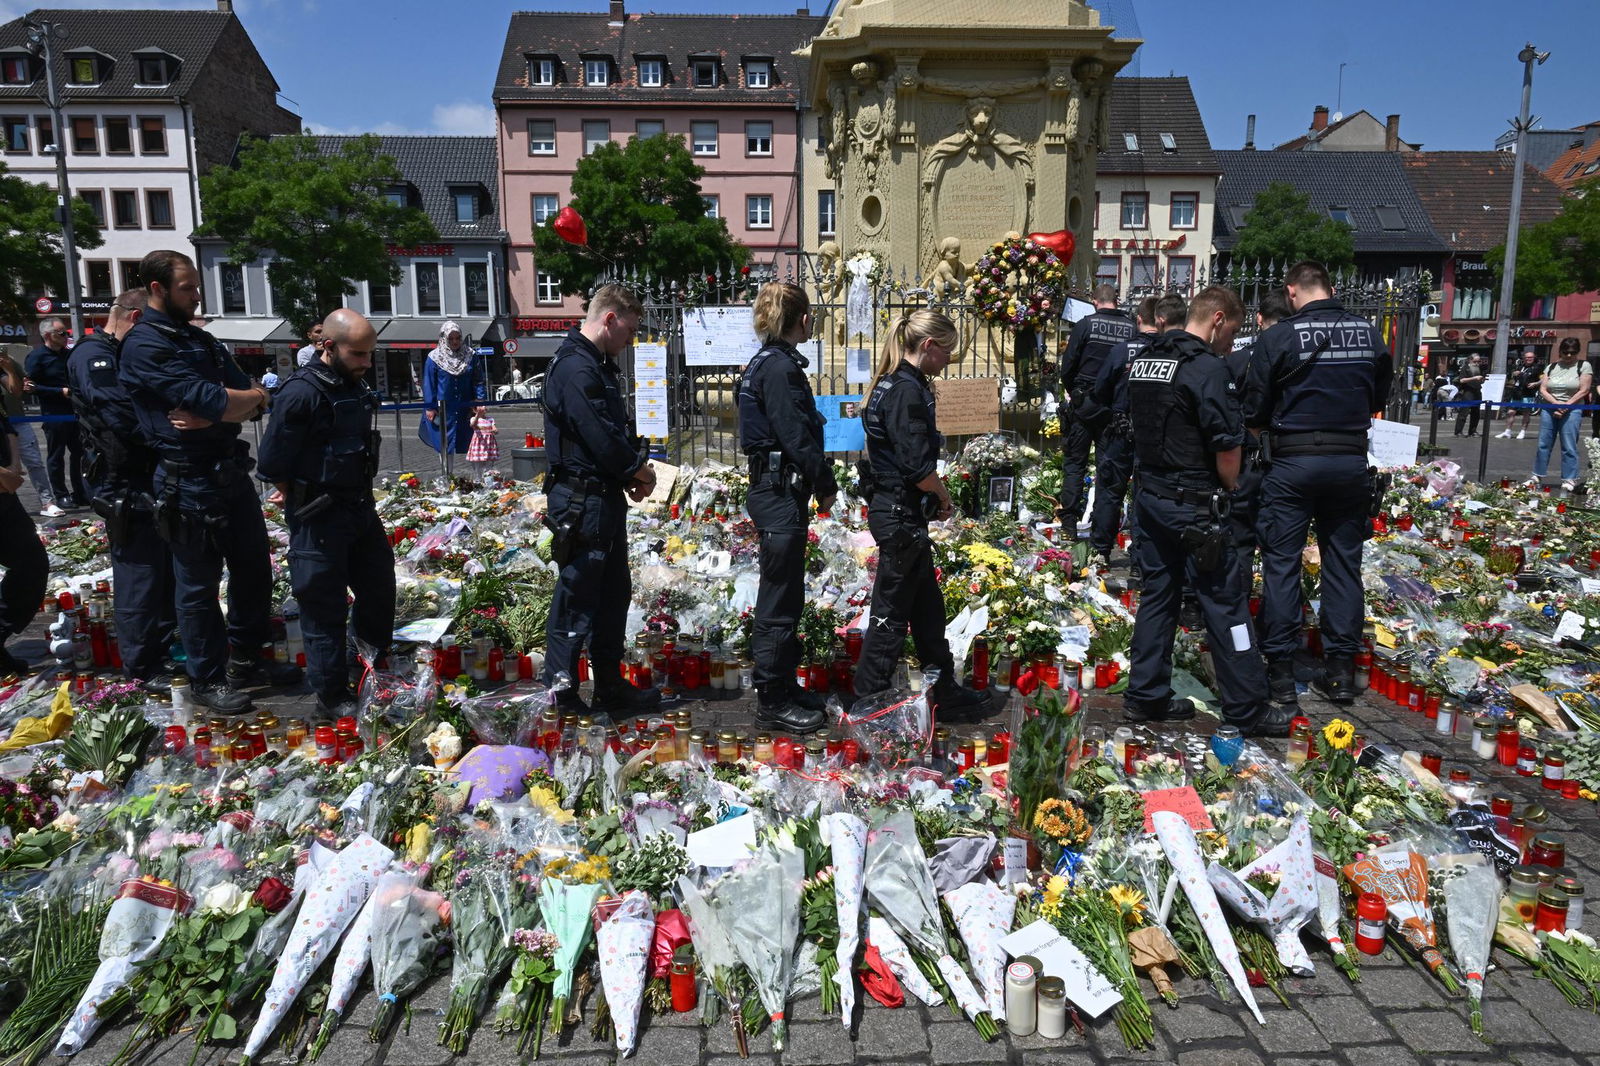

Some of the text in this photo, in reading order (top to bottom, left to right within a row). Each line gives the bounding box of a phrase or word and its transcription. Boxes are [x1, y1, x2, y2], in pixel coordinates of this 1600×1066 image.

[1091, 322, 1133, 338] POLIZEI
[1299, 329, 1373, 349] POLIZEI
[1130, 361, 1175, 379] POLIZEI
[139, 887, 173, 905] Roses
